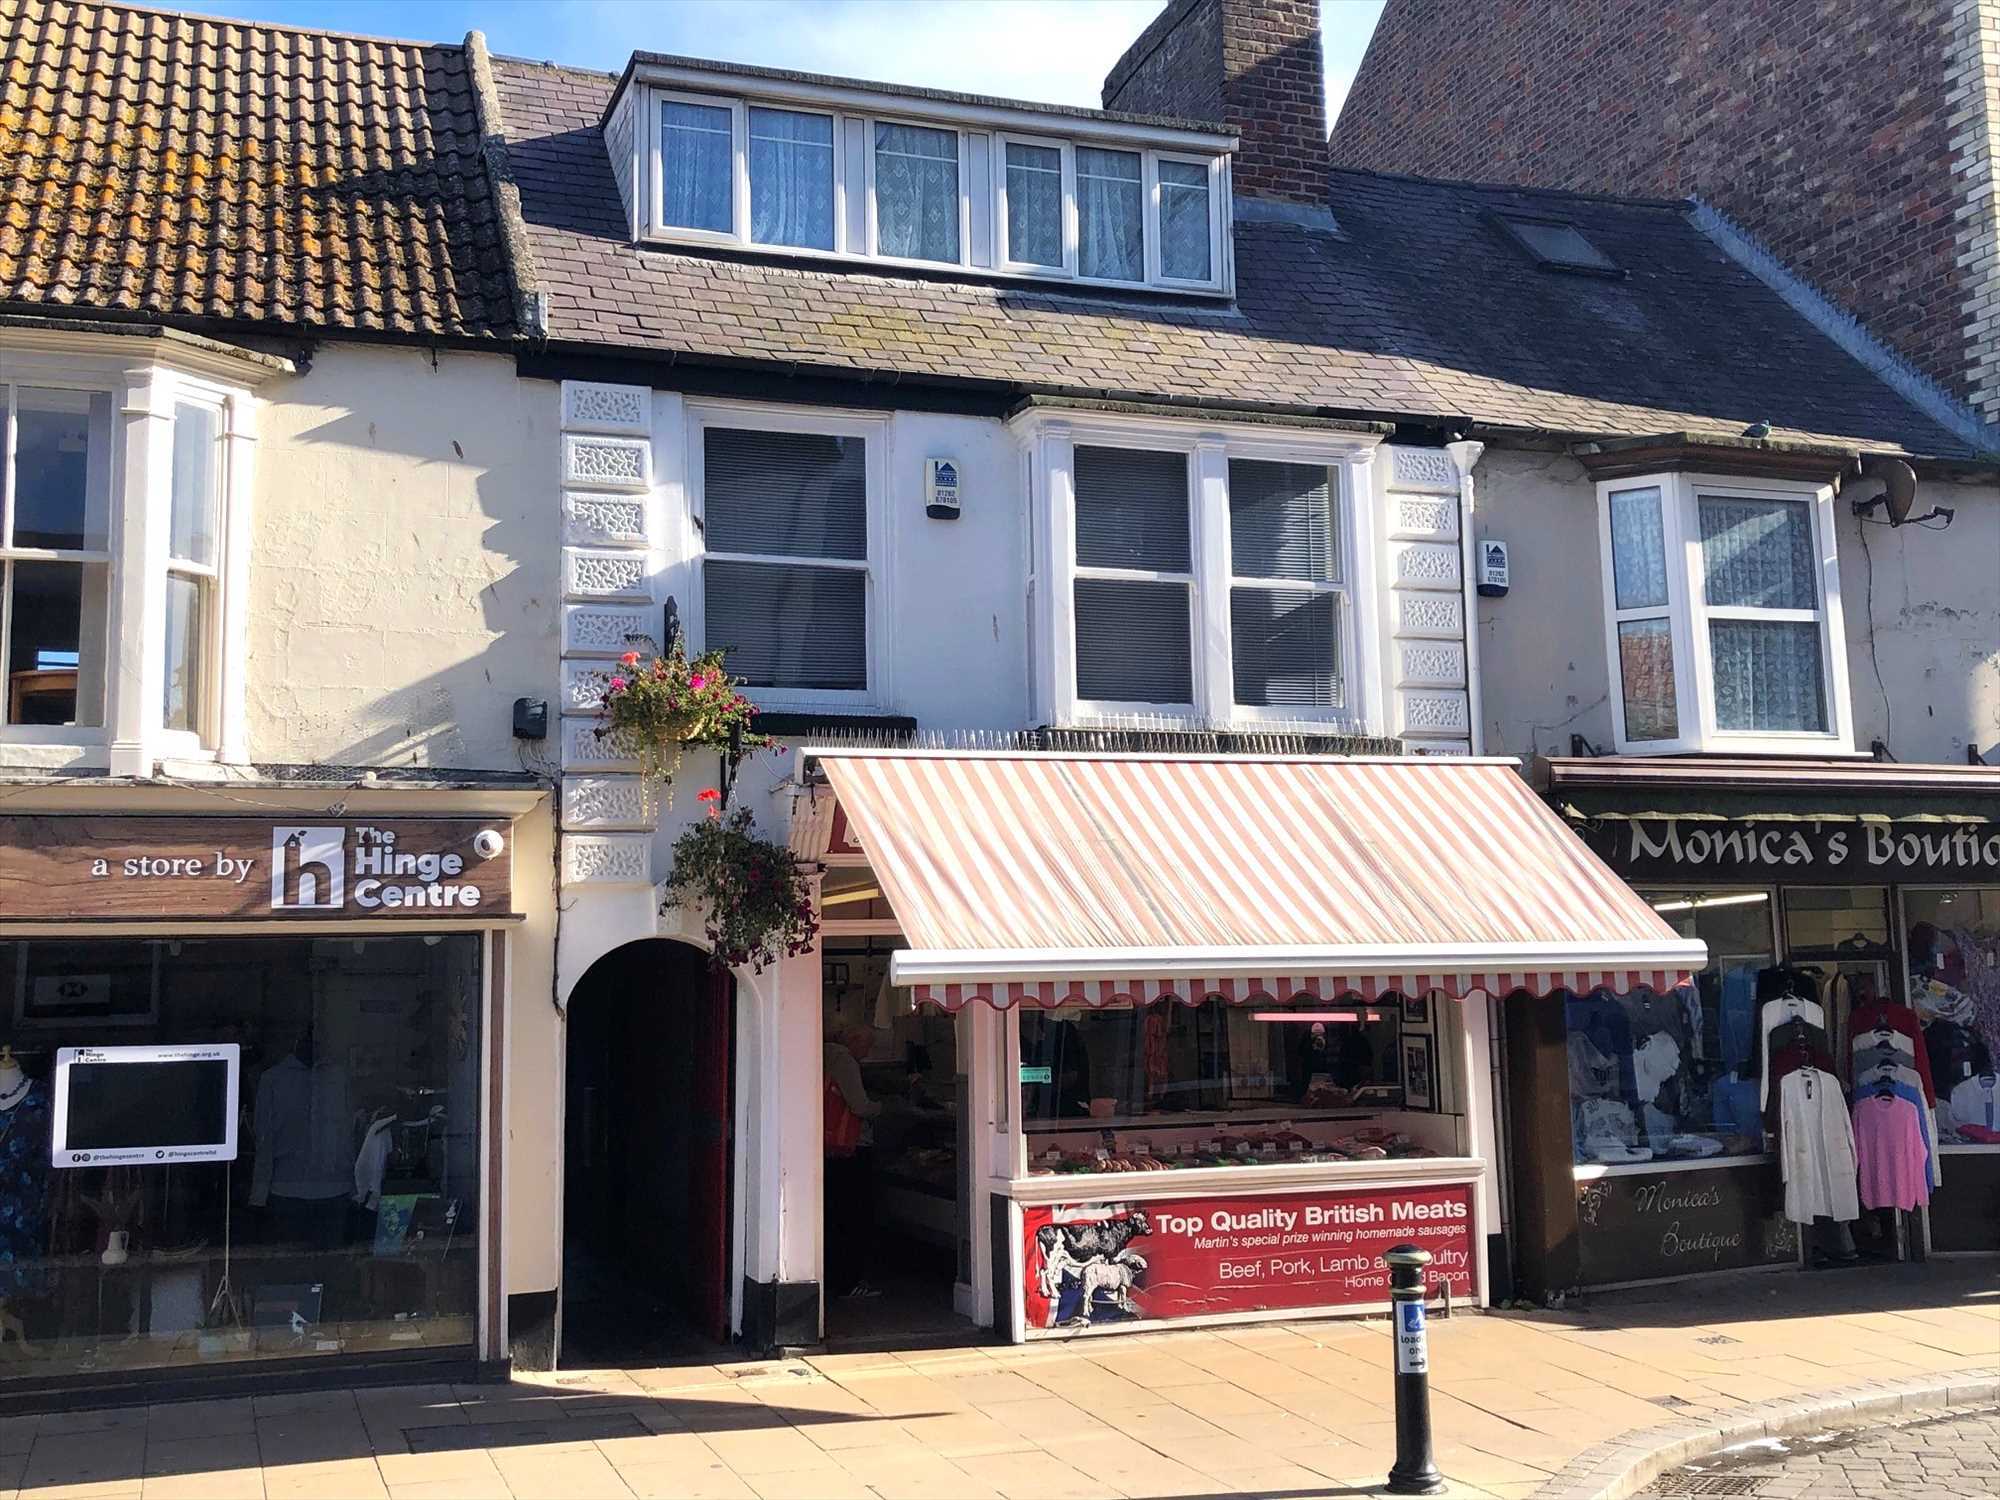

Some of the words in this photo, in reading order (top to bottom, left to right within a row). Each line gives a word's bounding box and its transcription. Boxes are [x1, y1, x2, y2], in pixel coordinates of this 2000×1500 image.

[355, 827, 395, 844] The
[1629, 818, 1849, 866] Monica's
[91, 858, 110, 877] a
[123, 856, 202, 877] store
[215, 851, 255, 884] by
[355, 846, 463, 882] Hinge
[354, 878, 481, 908] Centre
[1635, 1180, 1721, 1213] Monica's
[1156, 1214, 1203, 1237] Top
[1211, 1208, 1297, 1233] Quality
[1305, 1203, 1384, 1226] British
[1392, 1200, 1467, 1221] Meats
[1194, 1235, 1239, 1249] Martin's
[1241, 1232, 1280, 1247] special
[1282, 1231, 1309, 1246] prize
[1311, 1229, 1353, 1243] winning
[1355, 1226, 1415, 1241] homemade
[1417, 1224, 1466, 1238] sausages
[1661, 1220, 1743, 1263] Boutique
[1219, 1260, 1265, 1280] Beef,
[1271, 1258, 1315, 1277] Pork,
[1320, 1254, 1369, 1273] Lamb
[1345, 1275, 1384, 1288] Home
[1429, 1270, 1470, 1283] Bacon
